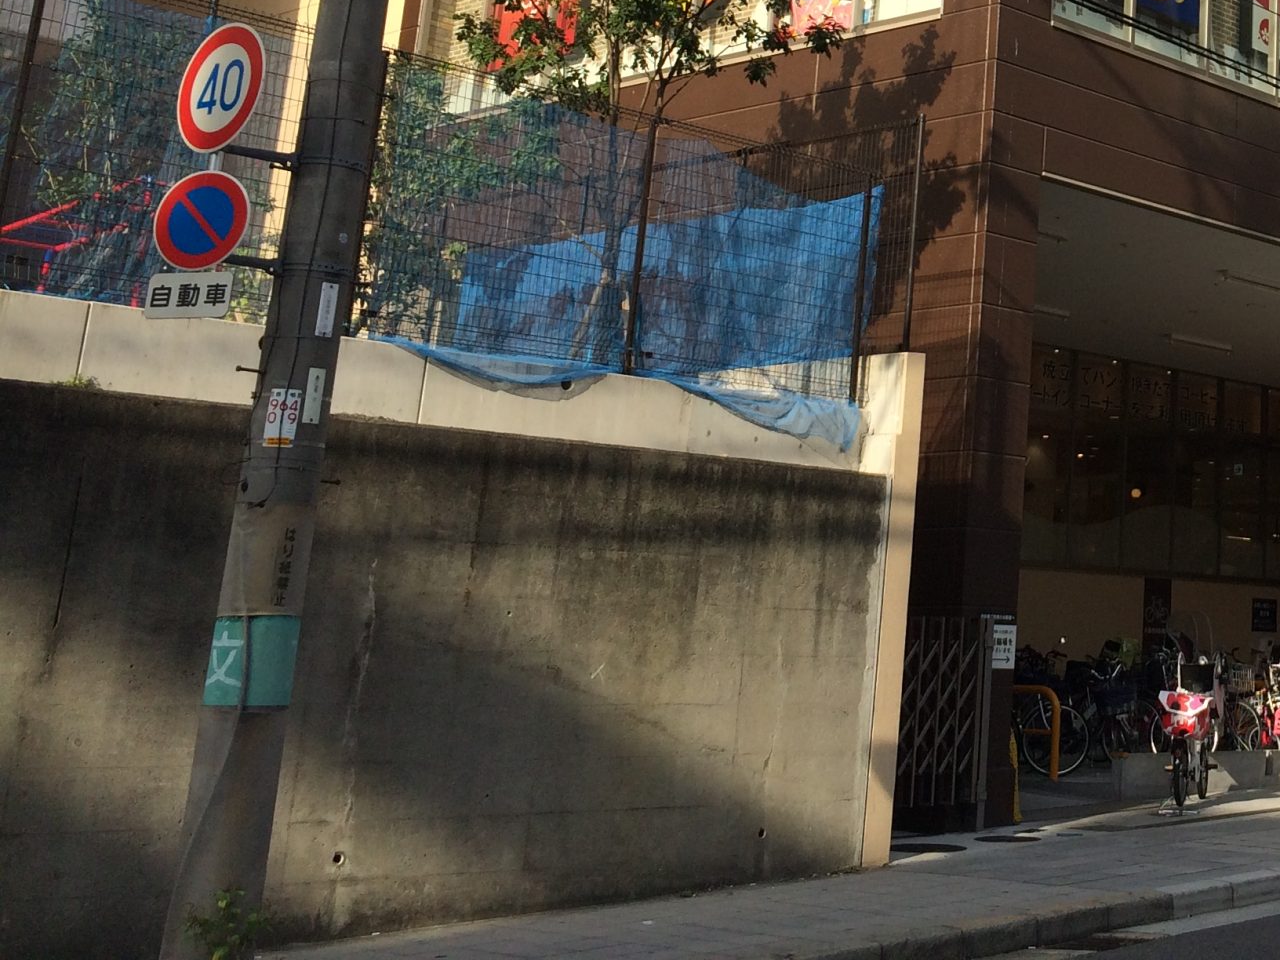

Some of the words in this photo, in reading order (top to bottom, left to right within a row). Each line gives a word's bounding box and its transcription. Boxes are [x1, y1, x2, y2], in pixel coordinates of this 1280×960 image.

[196, 58, 245, 115] 40
[150, 283, 228, 308] 自動車
